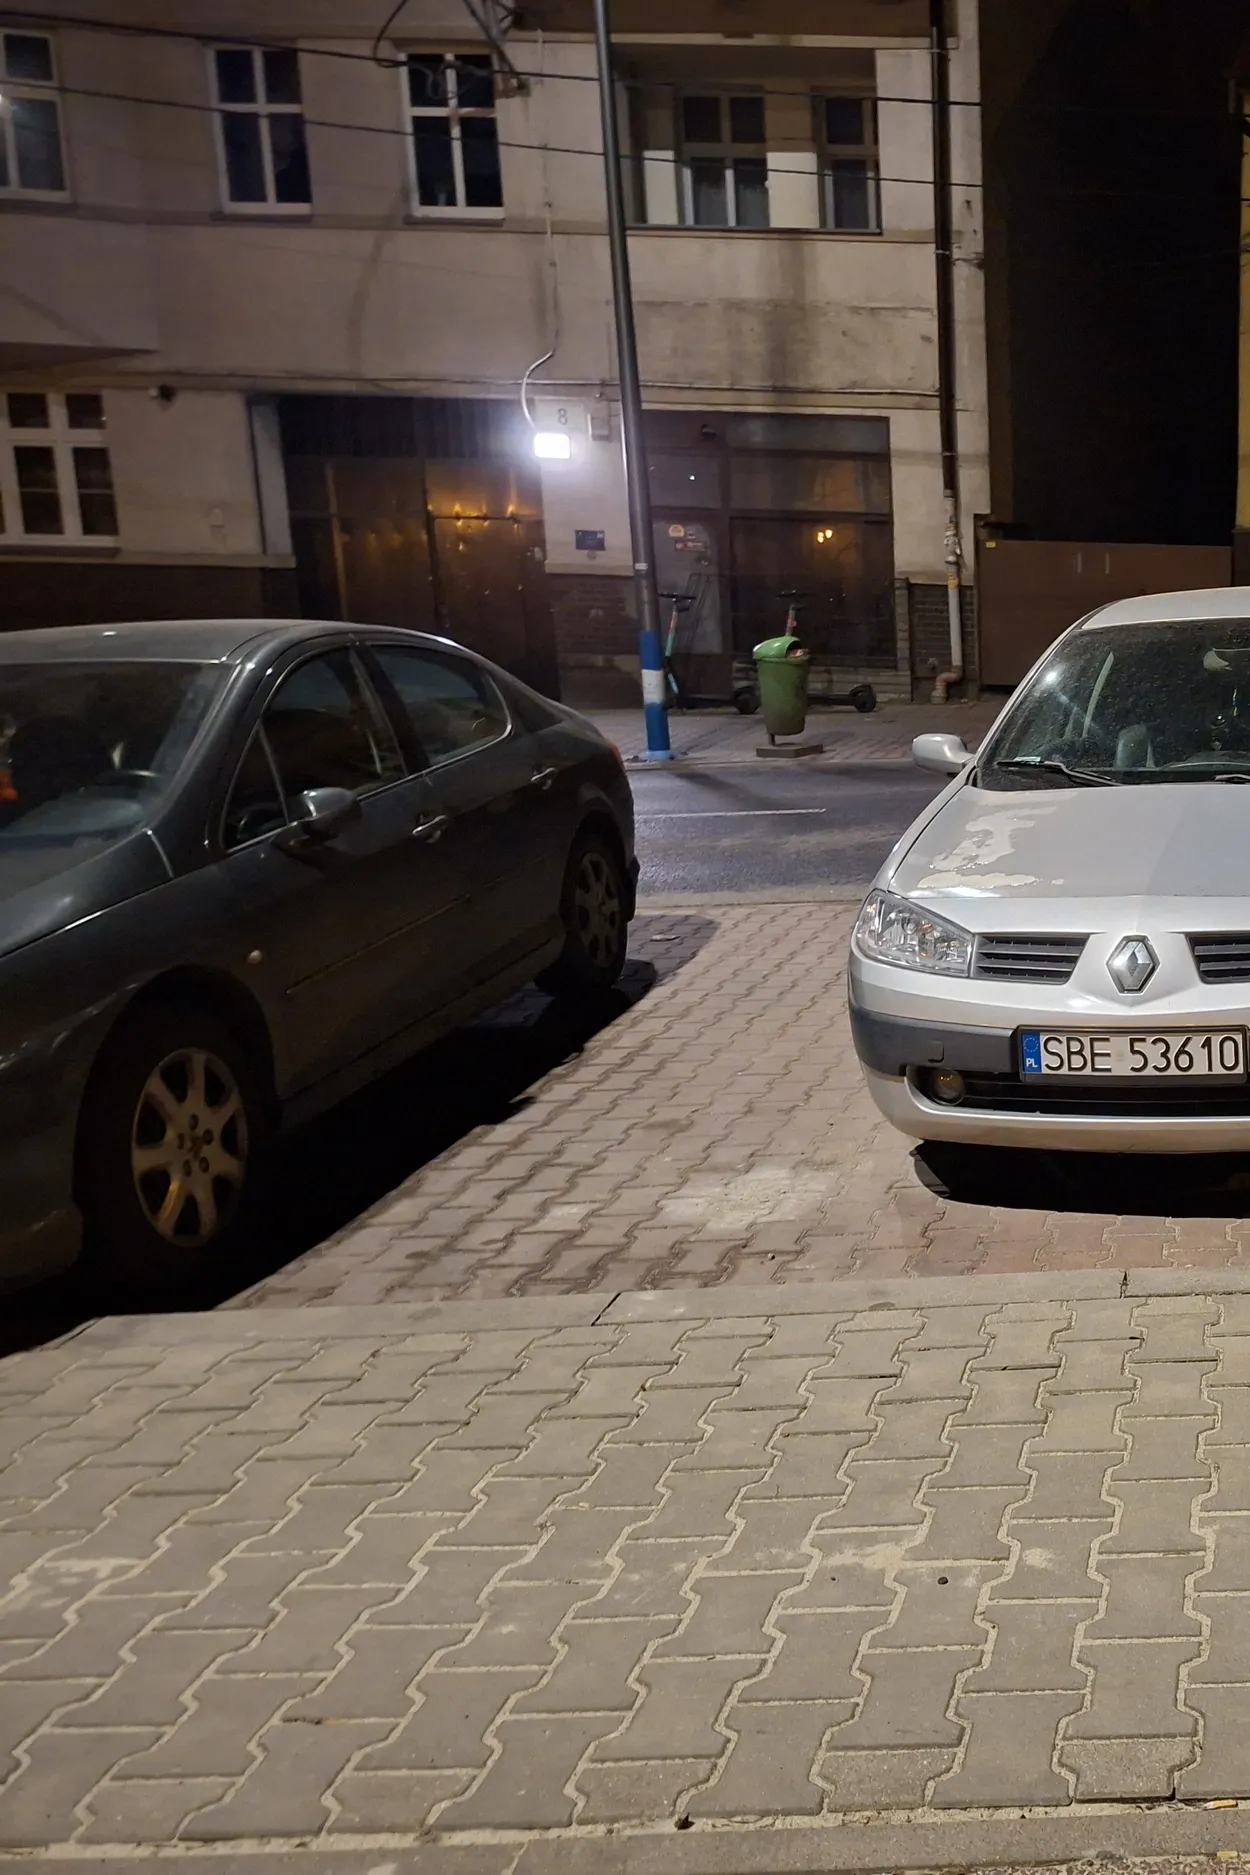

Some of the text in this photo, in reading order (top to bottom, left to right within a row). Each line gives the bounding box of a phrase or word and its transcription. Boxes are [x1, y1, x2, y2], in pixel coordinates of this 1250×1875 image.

[557, 408, 569, 426] 8
[1026, 1058, 1038, 1068] PL
[1043, 1036, 1239, 1073] SBE 53610
